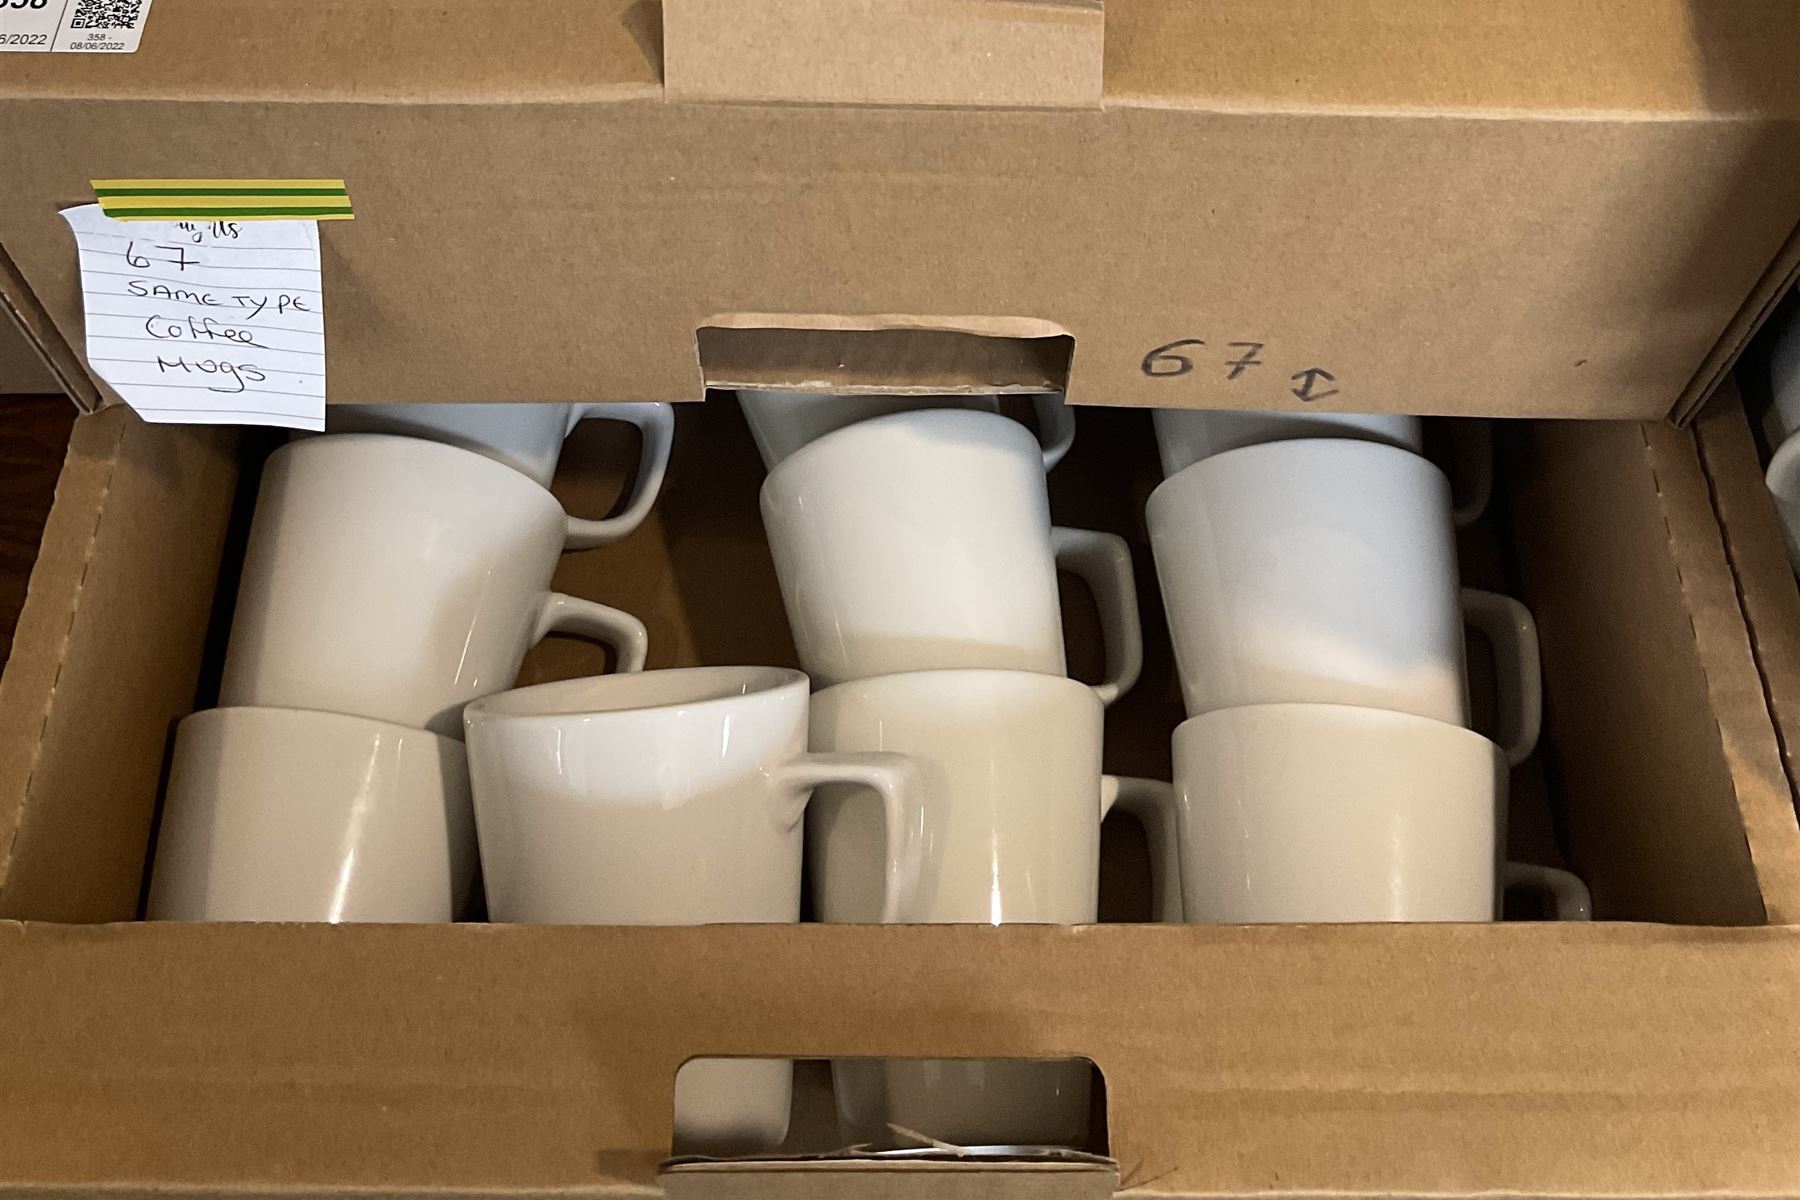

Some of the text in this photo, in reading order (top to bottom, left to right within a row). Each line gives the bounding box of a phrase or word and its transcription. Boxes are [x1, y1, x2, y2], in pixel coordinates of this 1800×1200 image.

[70, 42, 125, 50] 08/06/2022
[87, 33, 106, 41] 358
[126, 241, 200, 271] 67
[127, 280, 311, 321] SAME TYPE
[145, 314, 270, 349] Coffee
[1141, 338, 1265, 380] 67
